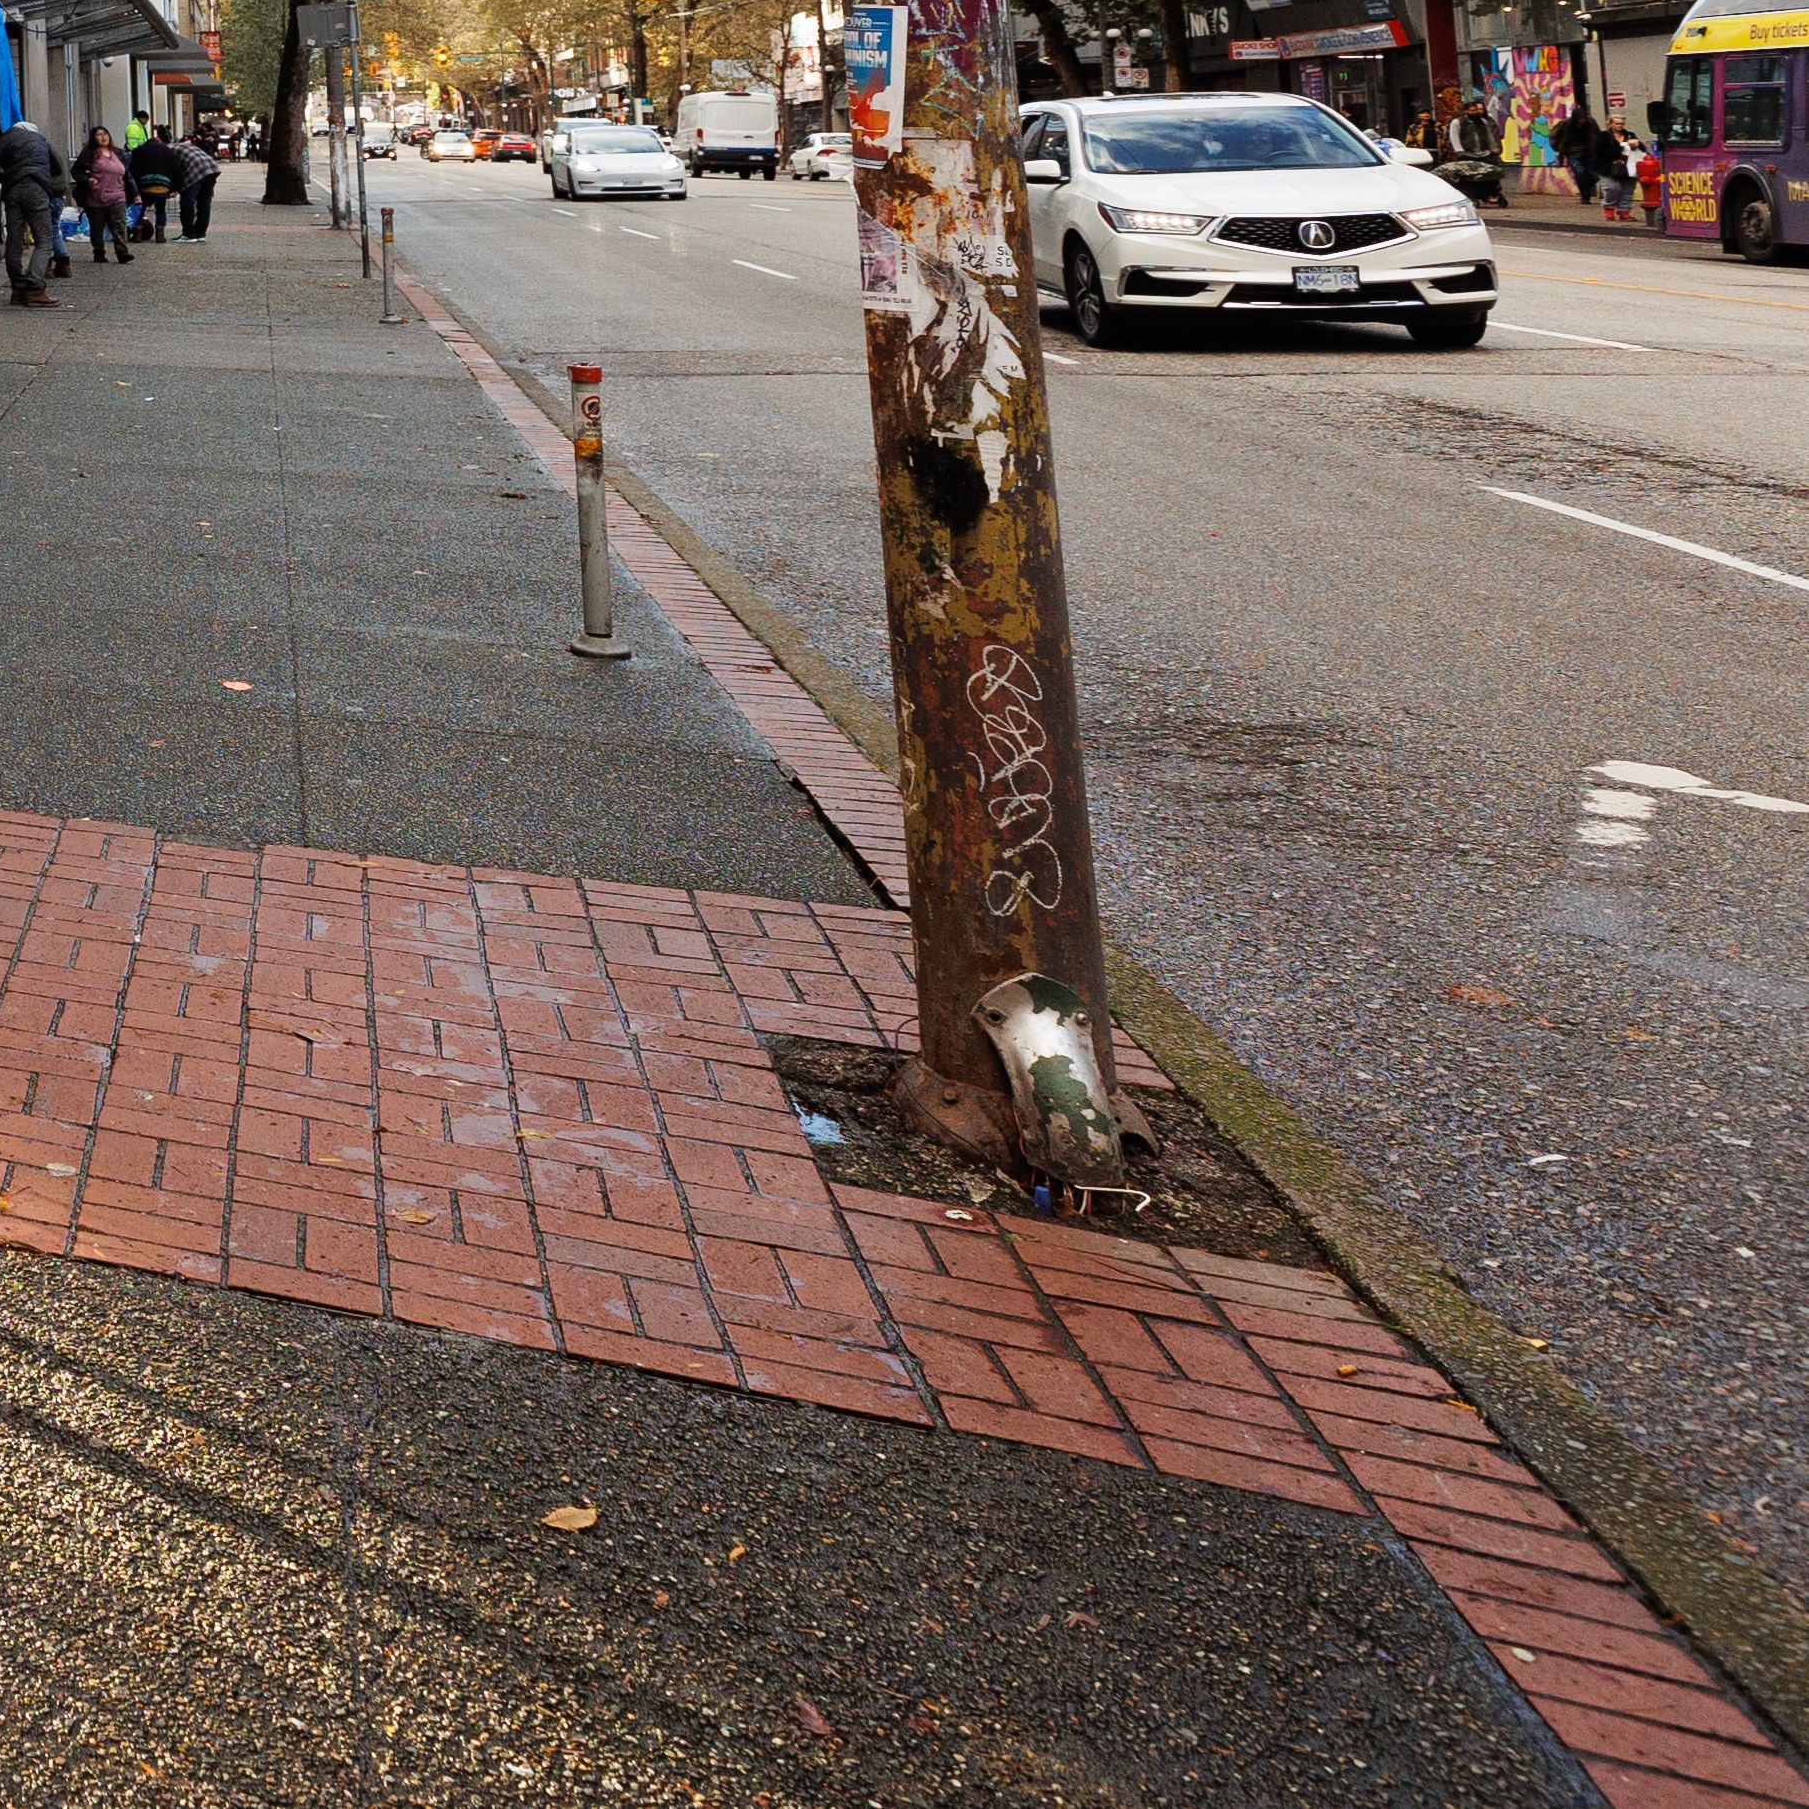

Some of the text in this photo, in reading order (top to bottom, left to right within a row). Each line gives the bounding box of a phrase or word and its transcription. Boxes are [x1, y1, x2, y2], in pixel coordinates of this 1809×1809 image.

[863, 32, 883, 50] OF
[1750, 21, 1808, 44] Buy tickets
[1668, 172, 1715, 196] SCIENCE
[1669, 196, 1717, 222] WORLD
